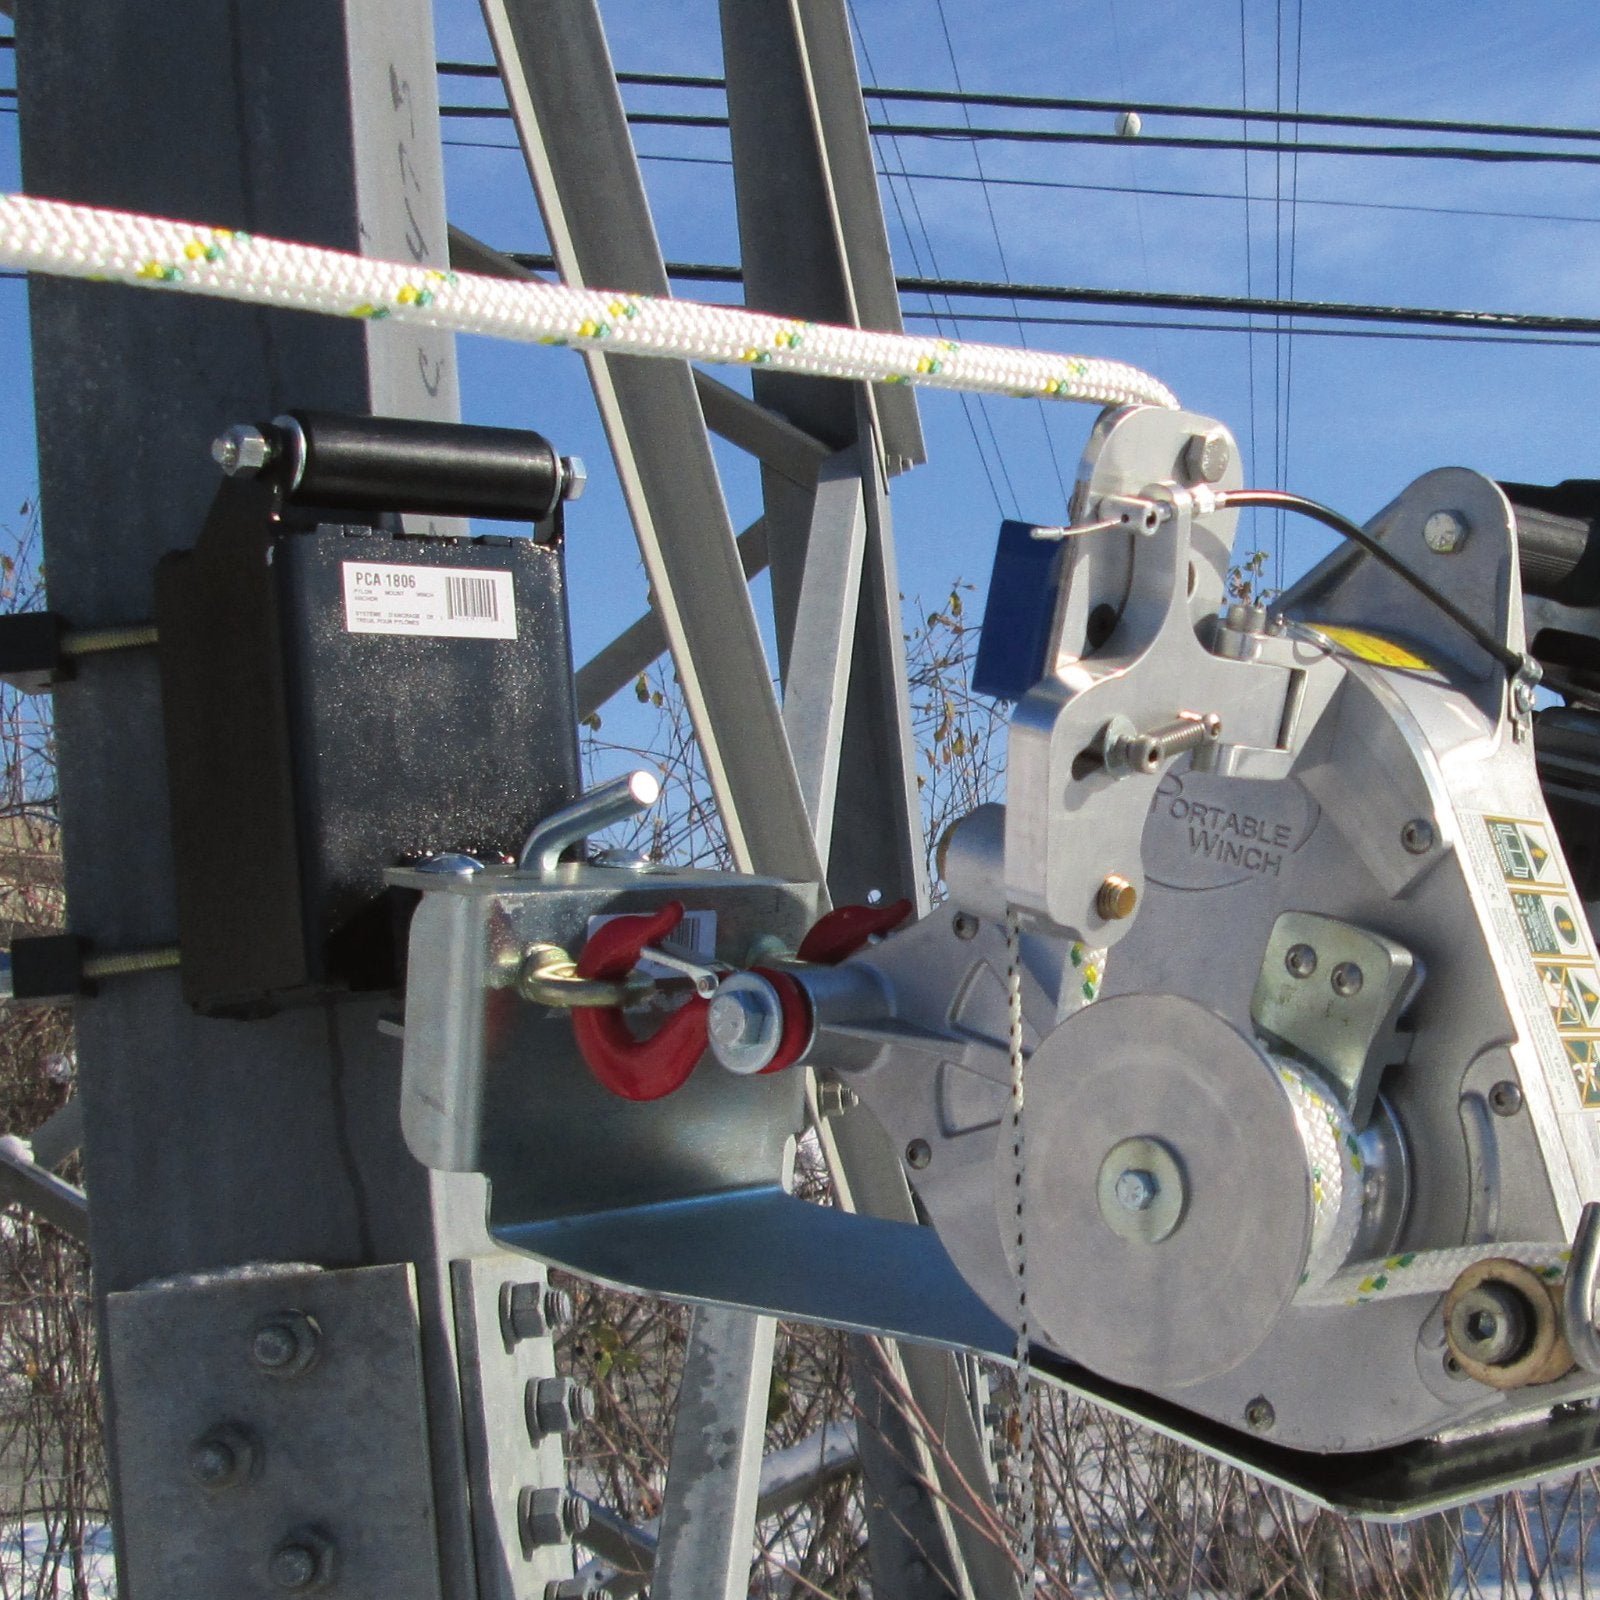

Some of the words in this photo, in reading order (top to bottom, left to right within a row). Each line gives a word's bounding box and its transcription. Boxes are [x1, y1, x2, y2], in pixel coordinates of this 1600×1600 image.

[355, 572, 381, 586] PCA
[385, 574, 416, 588] 1806
[1189, 826, 1283, 876] WINCH
